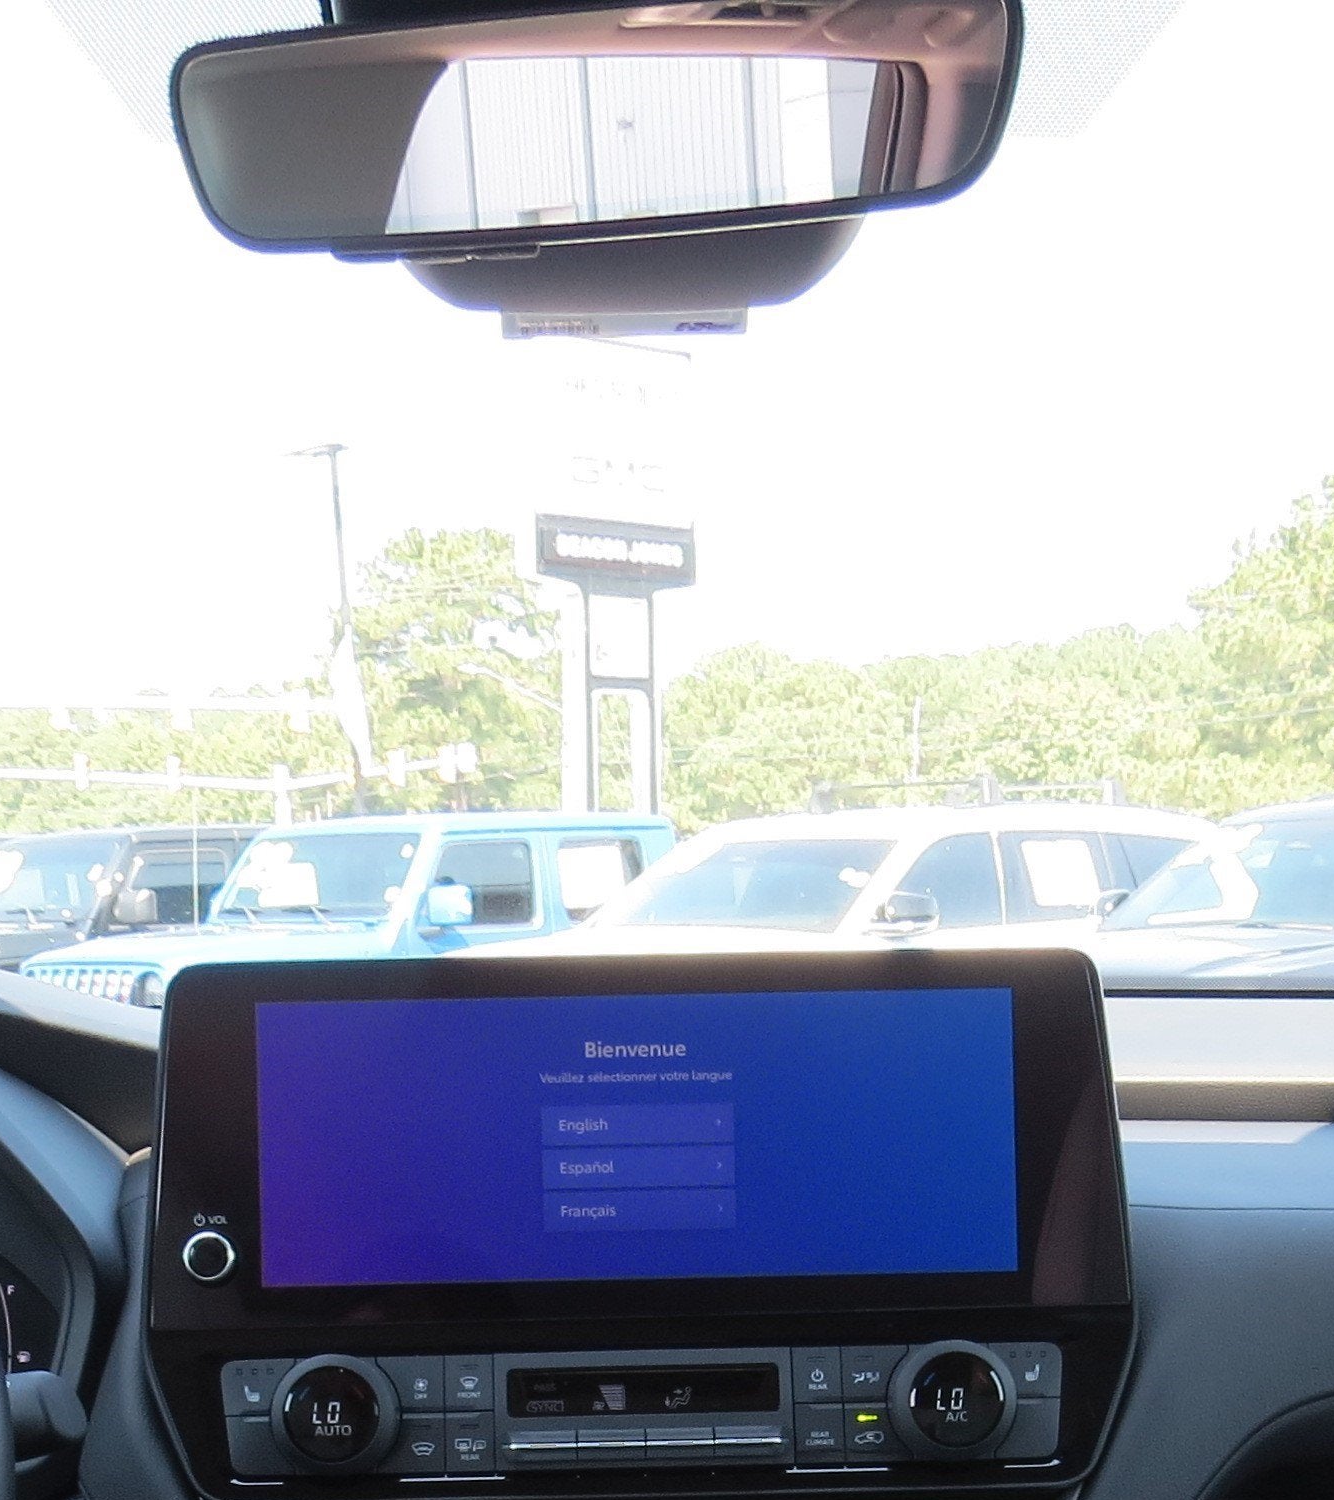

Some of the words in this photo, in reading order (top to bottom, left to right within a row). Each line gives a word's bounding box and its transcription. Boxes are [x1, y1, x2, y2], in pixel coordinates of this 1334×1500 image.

[584, 1041, 687, 1059] Bienvenue
[539, 1072, 584, 1084] Veuillez
[660, 1070, 689, 1082] votre
[692, 1070, 733, 1083] langue
[558, 1118, 609, 1134] English
[560, 1161, 615, 1176] Español
[561, 1204, 616, 1219] Français
[208, 1215, 228, 1225] VOL
[7, 1285, 16, 1295] F
[808, 1383, 829, 1391] REAR
[457, 1391, 481, 1399] FRONT
[945, 1411, 969, 1423] A/C
[314, 1424, 353, 1437] AUTO
[805, 1438, 835, 1446] CLIMATE
[460, 1453, 480, 1461] REAR
